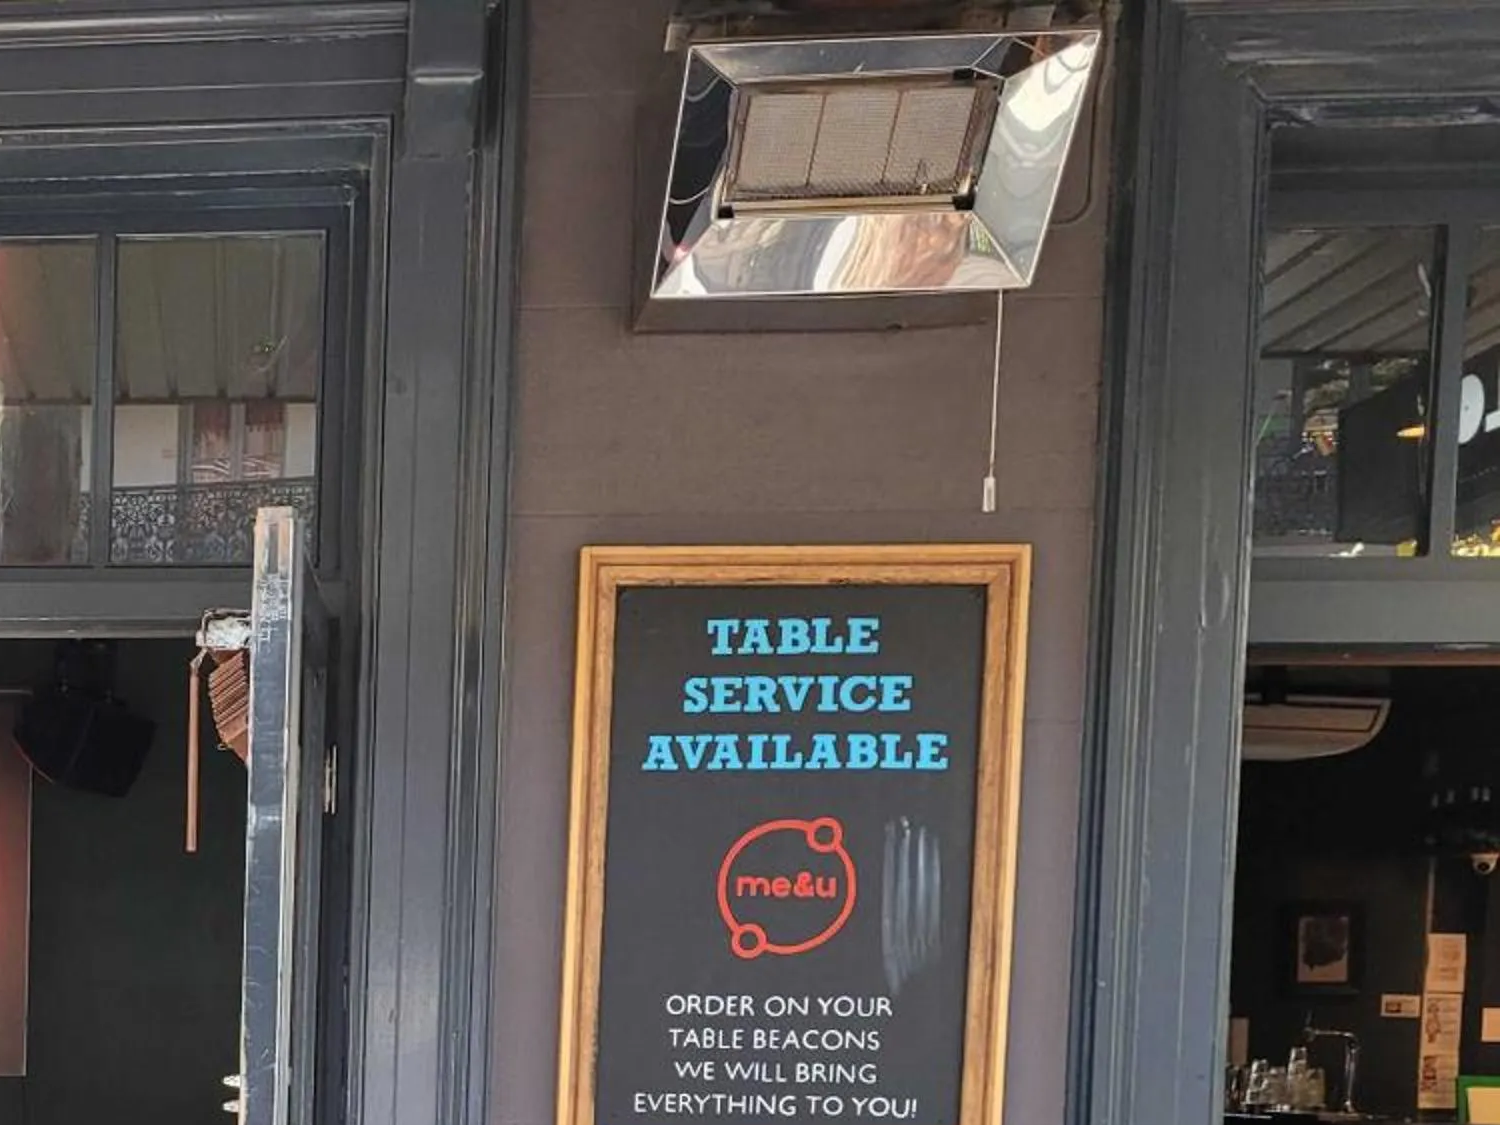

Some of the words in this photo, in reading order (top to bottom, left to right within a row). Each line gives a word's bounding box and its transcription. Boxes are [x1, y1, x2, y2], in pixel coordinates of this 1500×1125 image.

[707, 617, 880, 655] TABLE
[682, 675, 913, 713] SERVICE
[641, 732, 949, 771] AVAILABLE
[735, 870, 836, 898] me&u
[666, 994, 755, 1017] ORDER
[764, 995, 810, 1017] ON
[817, 995, 893, 1018] YOUR
[668, 1028, 745, 1050] TABLE
[753, 1028, 880, 1051] BEACONS
[674, 1060, 716, 1082] WE
[724, 1061, 787, 1083] WILL
[795, 1062, 877, 1084] BRING
[633, 1093, 797, 1117] EVERYTHING
[806, 1095, 844, 1117] TO
[851, 1097, 918, 1119] YOU!
